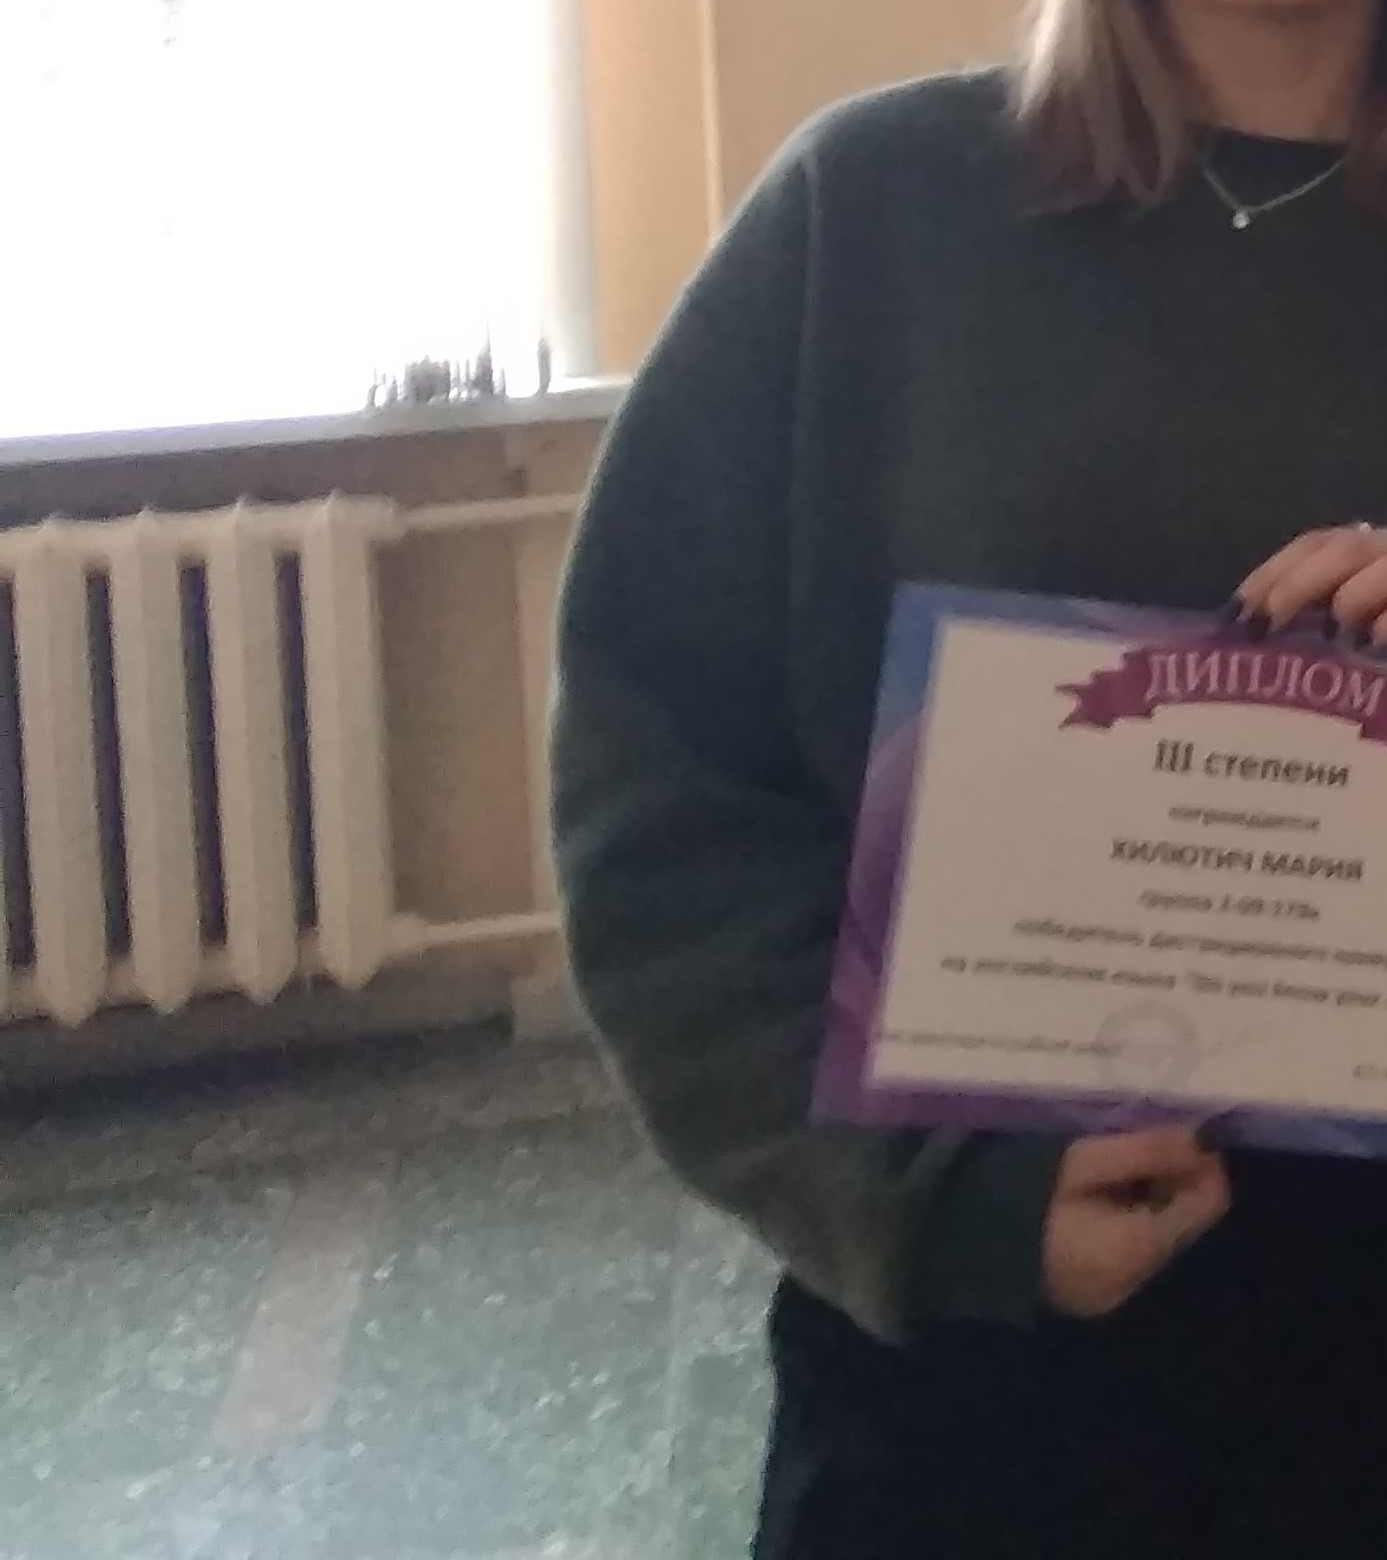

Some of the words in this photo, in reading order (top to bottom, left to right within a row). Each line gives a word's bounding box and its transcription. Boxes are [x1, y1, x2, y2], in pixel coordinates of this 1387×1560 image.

[1147, 650, 1384, 717] ДИПЛОМ
[1153, 739, 1194, 775] III
[1203, 750, 1351, 788] степени
[1260, 849, 1365, 882] МАРИЯ
